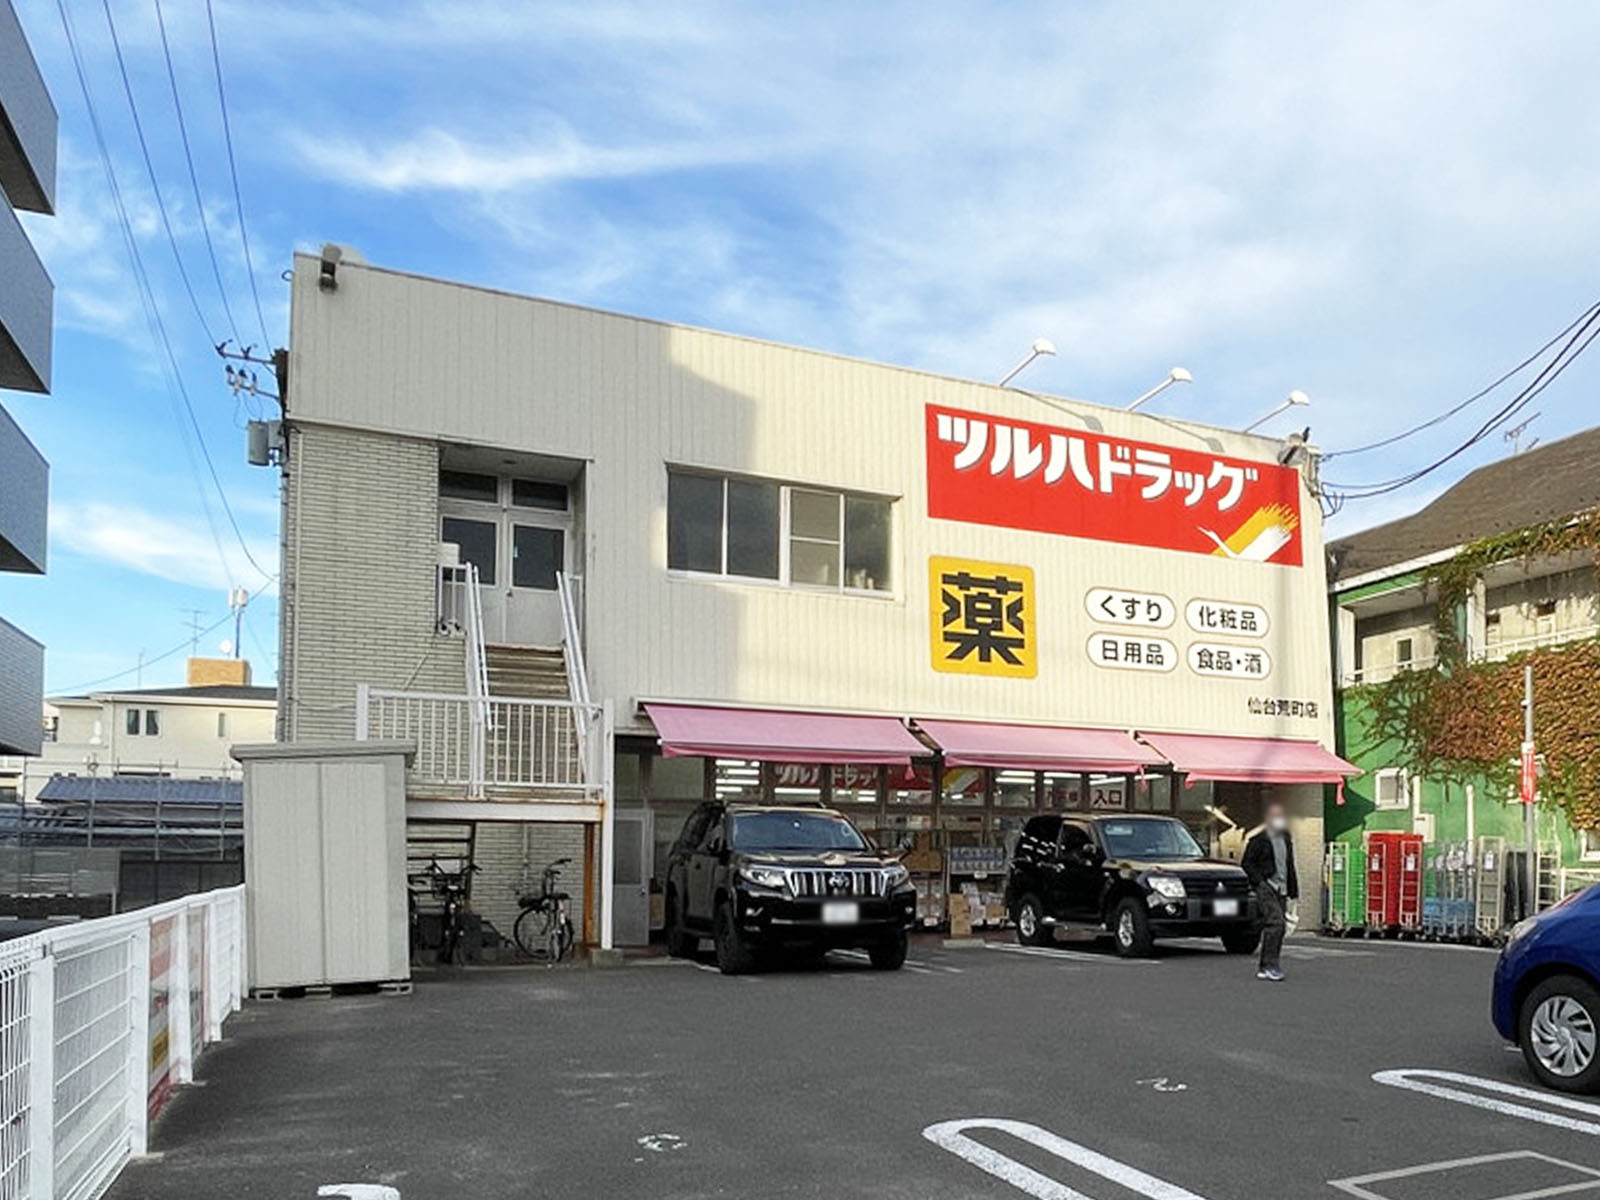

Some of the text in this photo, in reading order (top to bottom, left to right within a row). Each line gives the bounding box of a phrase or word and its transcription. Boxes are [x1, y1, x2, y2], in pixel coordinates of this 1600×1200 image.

[936, 413, 1259, 512] ツルハドラッグ
[941, 571, 1025, 666] 薬
[1100, 594, 1163, 622] くすり
[1198, 605, 1258, 632] 化粧品
[1102, 639, 1164, 666] 日用品
[1197, 647, 1262, 674] 食品・酒
[1093, 789, 1122, 806] 入口
